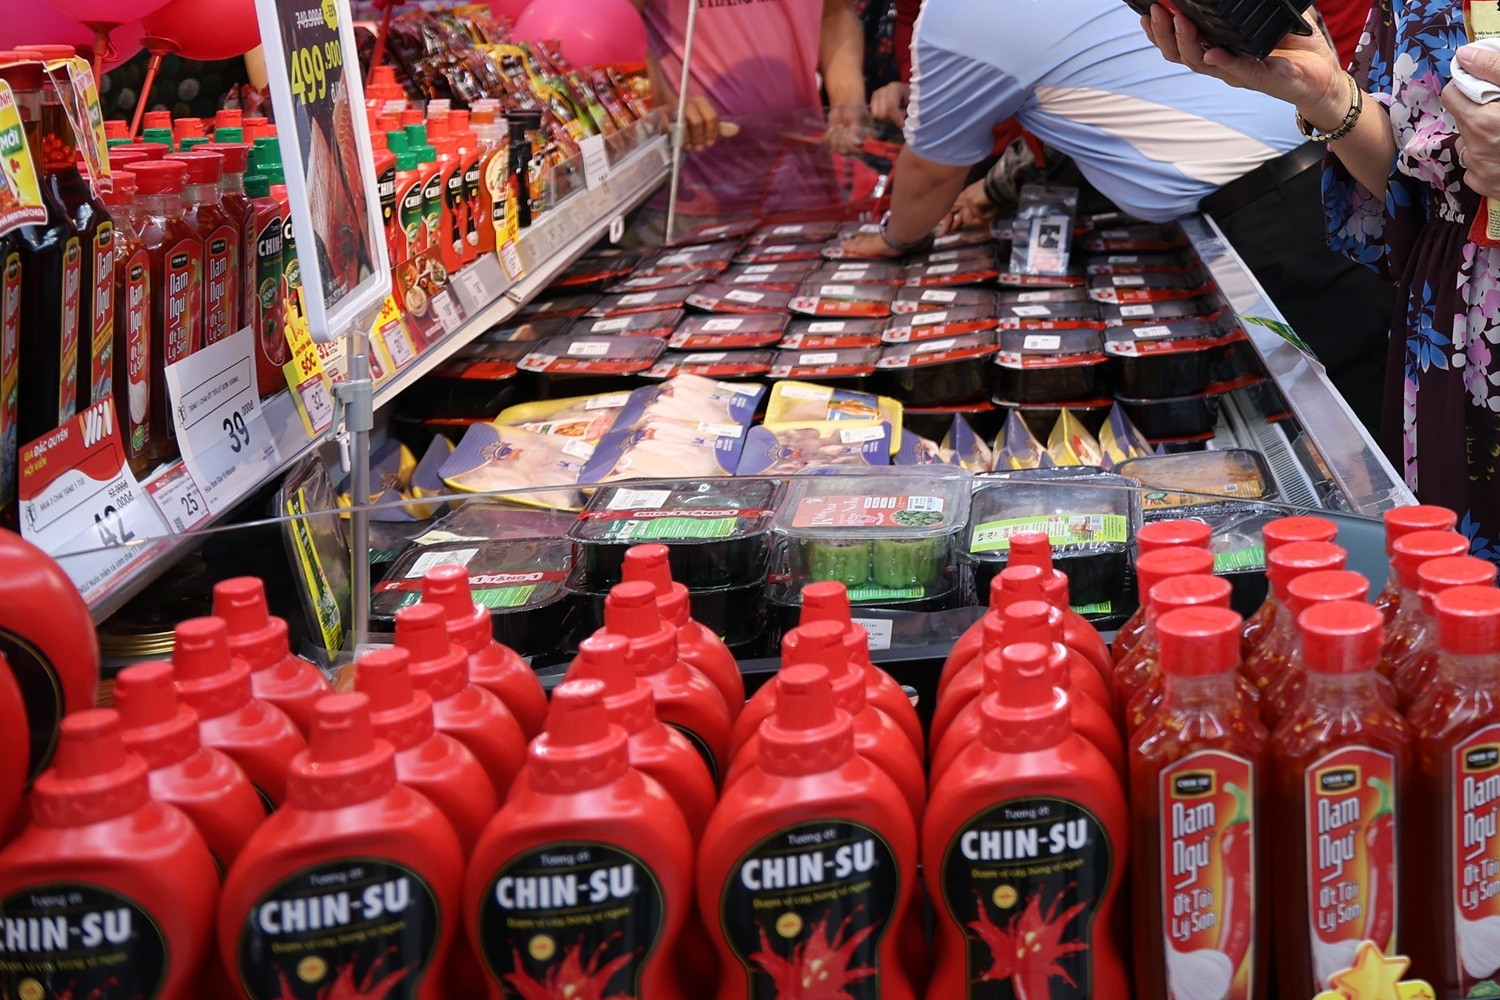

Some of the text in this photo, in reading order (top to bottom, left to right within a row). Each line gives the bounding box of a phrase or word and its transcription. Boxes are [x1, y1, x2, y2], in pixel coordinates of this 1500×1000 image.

[1, 129, 20, 149] MỚI
[170, 271, 188, 297] Nam
[210, 257, 226, 280] Nam
[170, 293, 186, 329] Ngư
[301, 347, 317, 376] SỐC
[312, 391, 321, 411] 32
[33, 438, 48, 457] ĐẶC
[47, 426, 69, 449] QUYỀN
[181, 492, 198, 516] 25
[488, 574, 525, 583] TẶNG
[1463, 774, 1500, 812] Nam
[1172, 801, 1215, 839] Nam
[1318, 796, 1360, 834] Nam
[961, 818, 1087, 861] CHIN-SU
[1464, 806, 1499, 861] Ngư
[741, 838, 875, 891] CHIN-SU
[1173, 833, 1210, 890] Ngư
[1319, 829, 1355, 883] Ngư
[496, 863, 634, 909] CHIN-SU
[1463, 858, 1499, 886] Ớt Tỏi
[259, 877, 410, 935] CHIN-SU
[1173, 887, 1213, 916] Ớt Tỏi
[1320, 880, 1359, 909] Ớt Tỏi
[1462, 880, 1500, 910] Lý Sơn
[0, 908, 132, 952] HIN-SU
[1172, 910, 1217, 942] Lý Sơn
[1318, 903, 1362, 932] Lý Sơn
